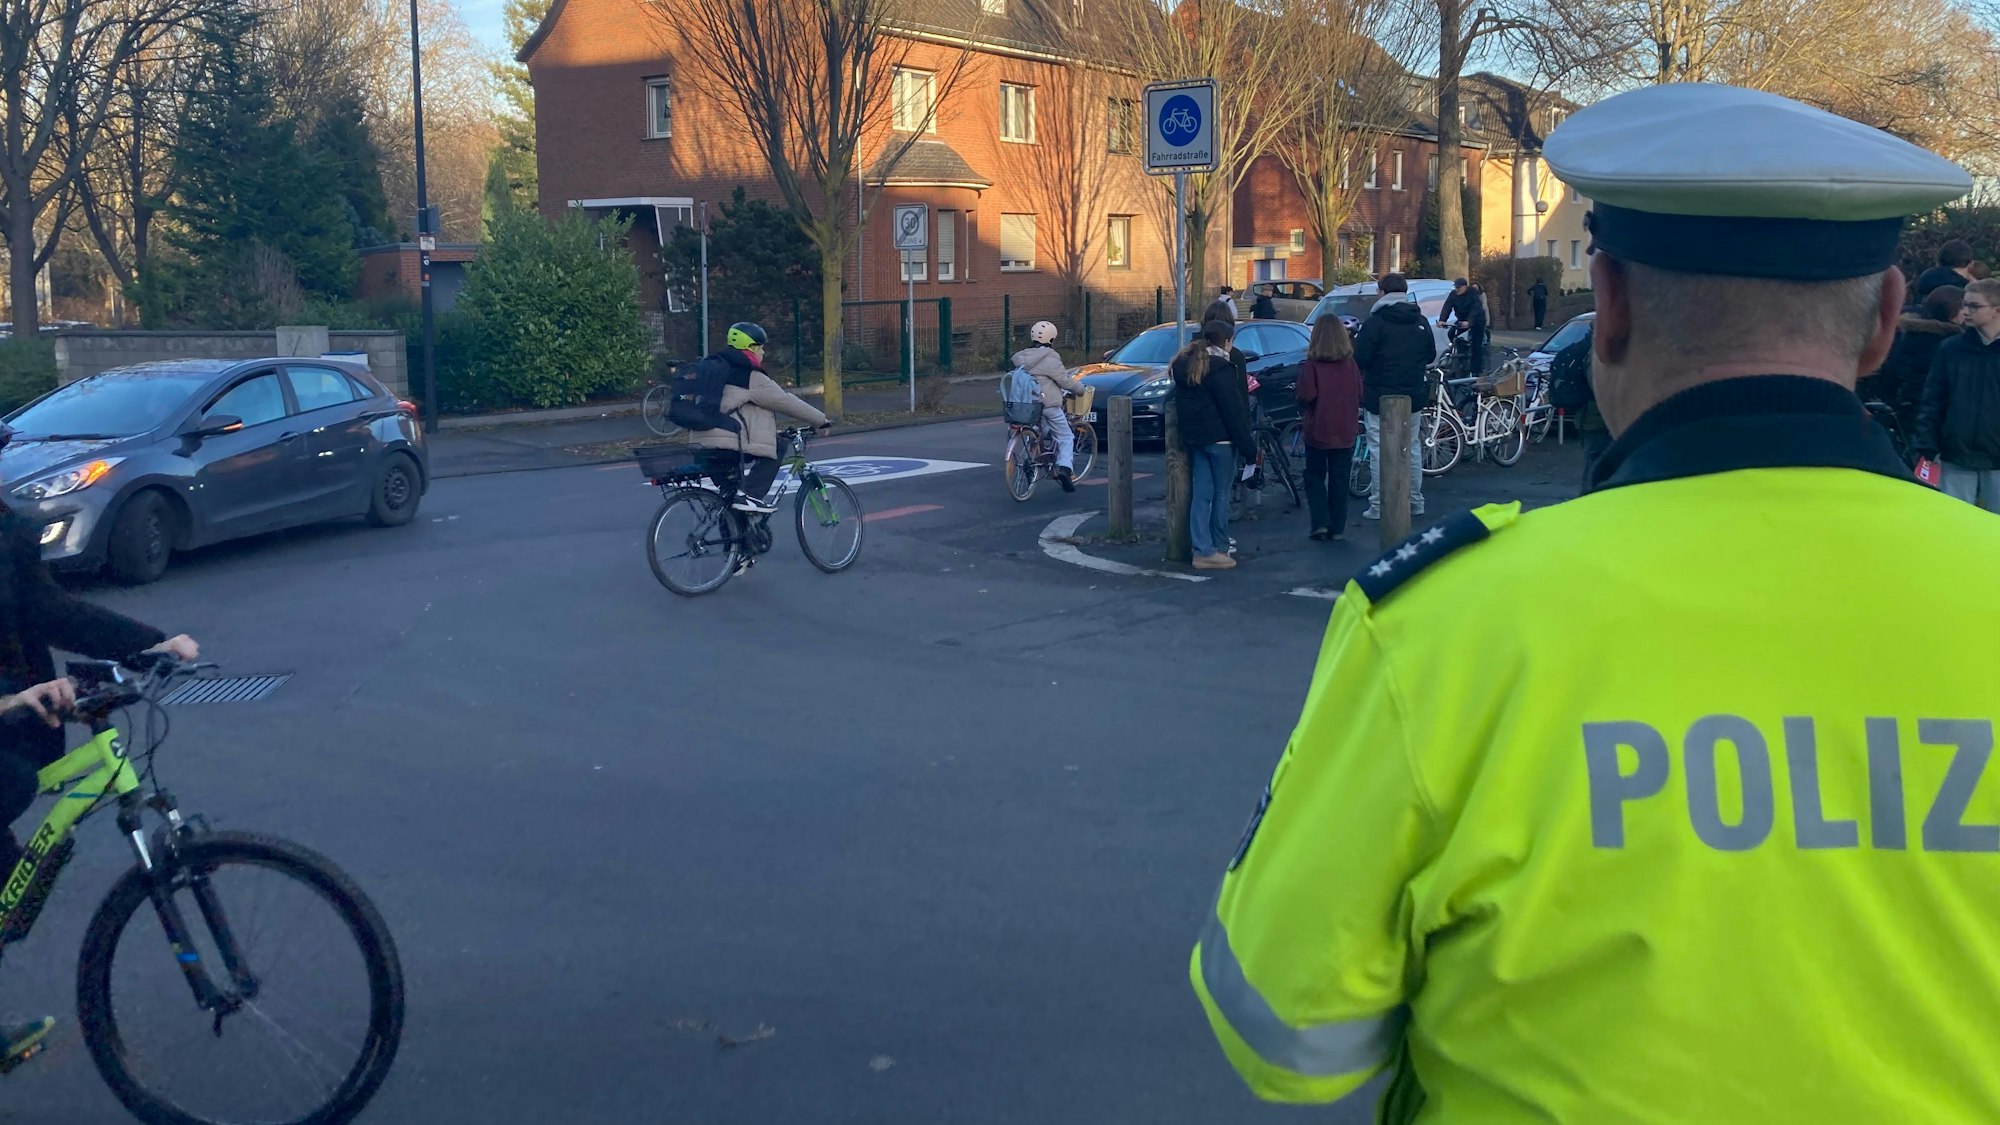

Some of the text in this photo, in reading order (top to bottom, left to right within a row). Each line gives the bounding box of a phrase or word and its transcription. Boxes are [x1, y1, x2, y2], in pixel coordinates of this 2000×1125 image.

[1152, 150, 1209, 161] Fahrradstraße
[904, 217, 916, 230] 30
[1582, 714, 2000, 852] POLIZ
